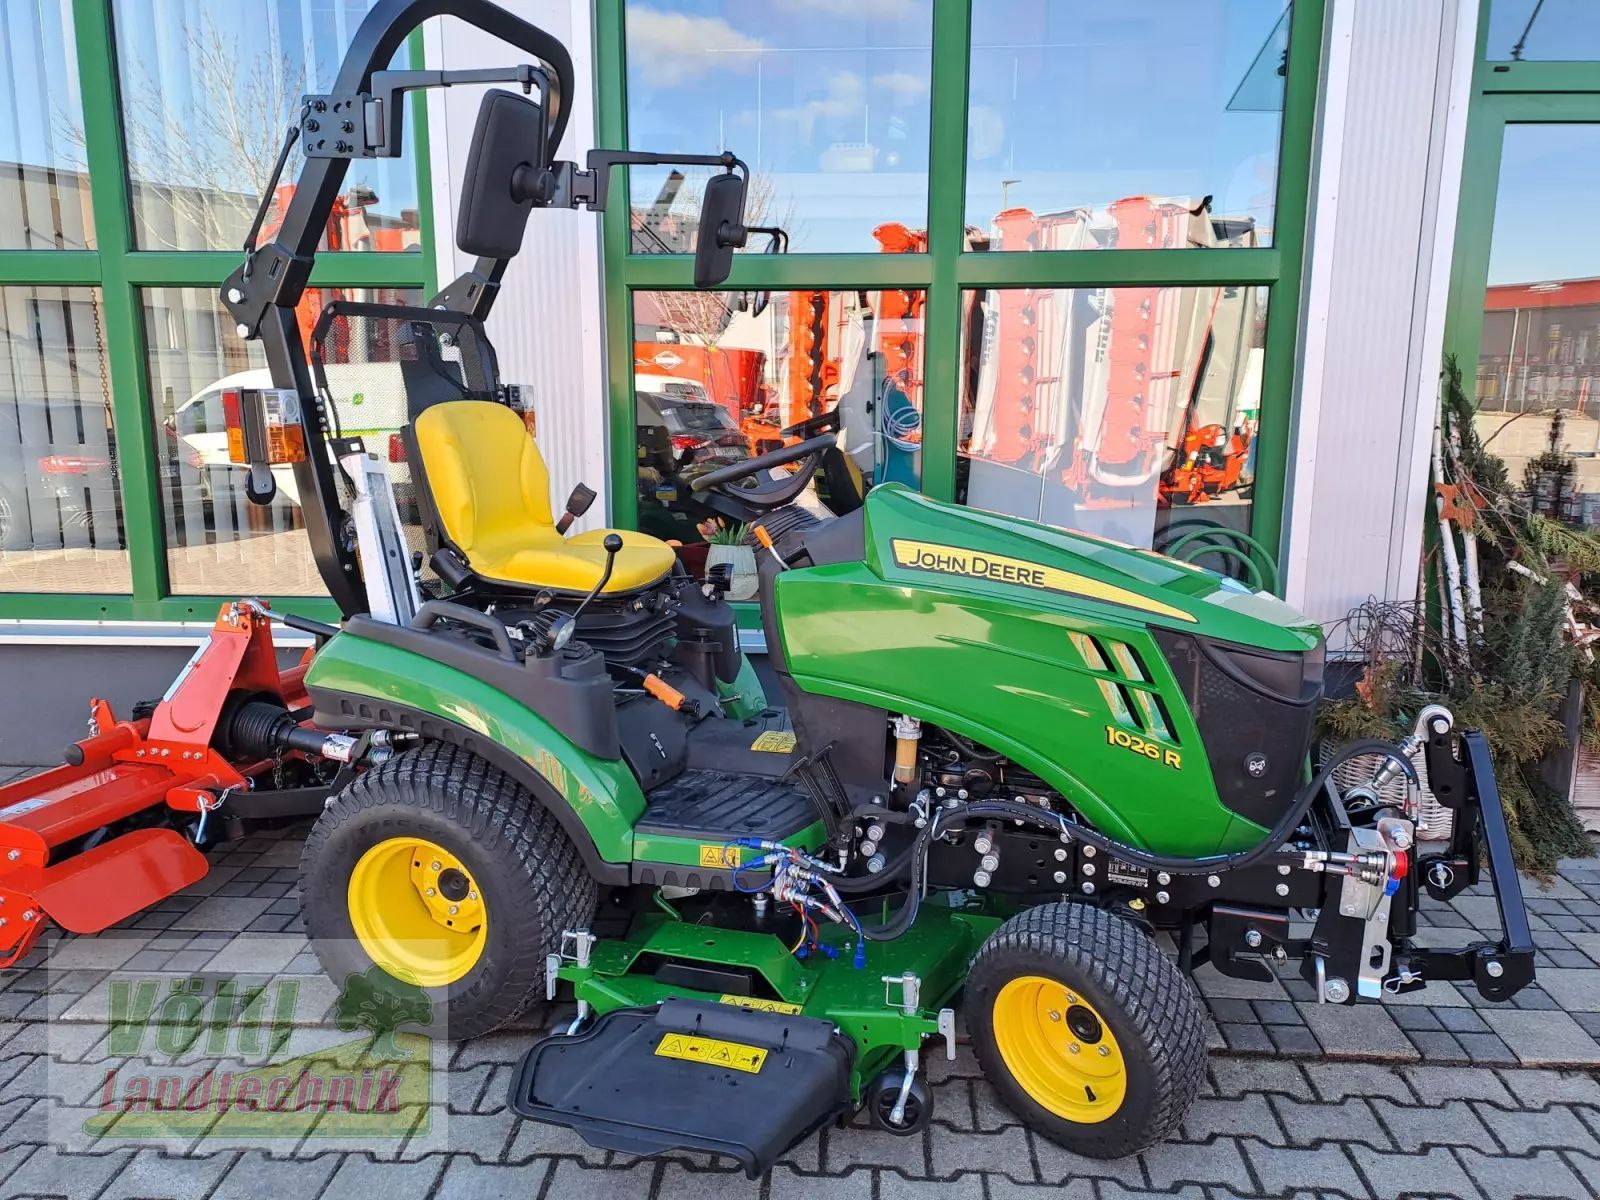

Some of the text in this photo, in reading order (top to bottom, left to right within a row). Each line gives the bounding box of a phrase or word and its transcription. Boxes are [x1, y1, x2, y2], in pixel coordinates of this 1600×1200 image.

[909, 548, 1045, 586] JOHN DEERE
[1105, 725, 1182, 771] 1026 R
